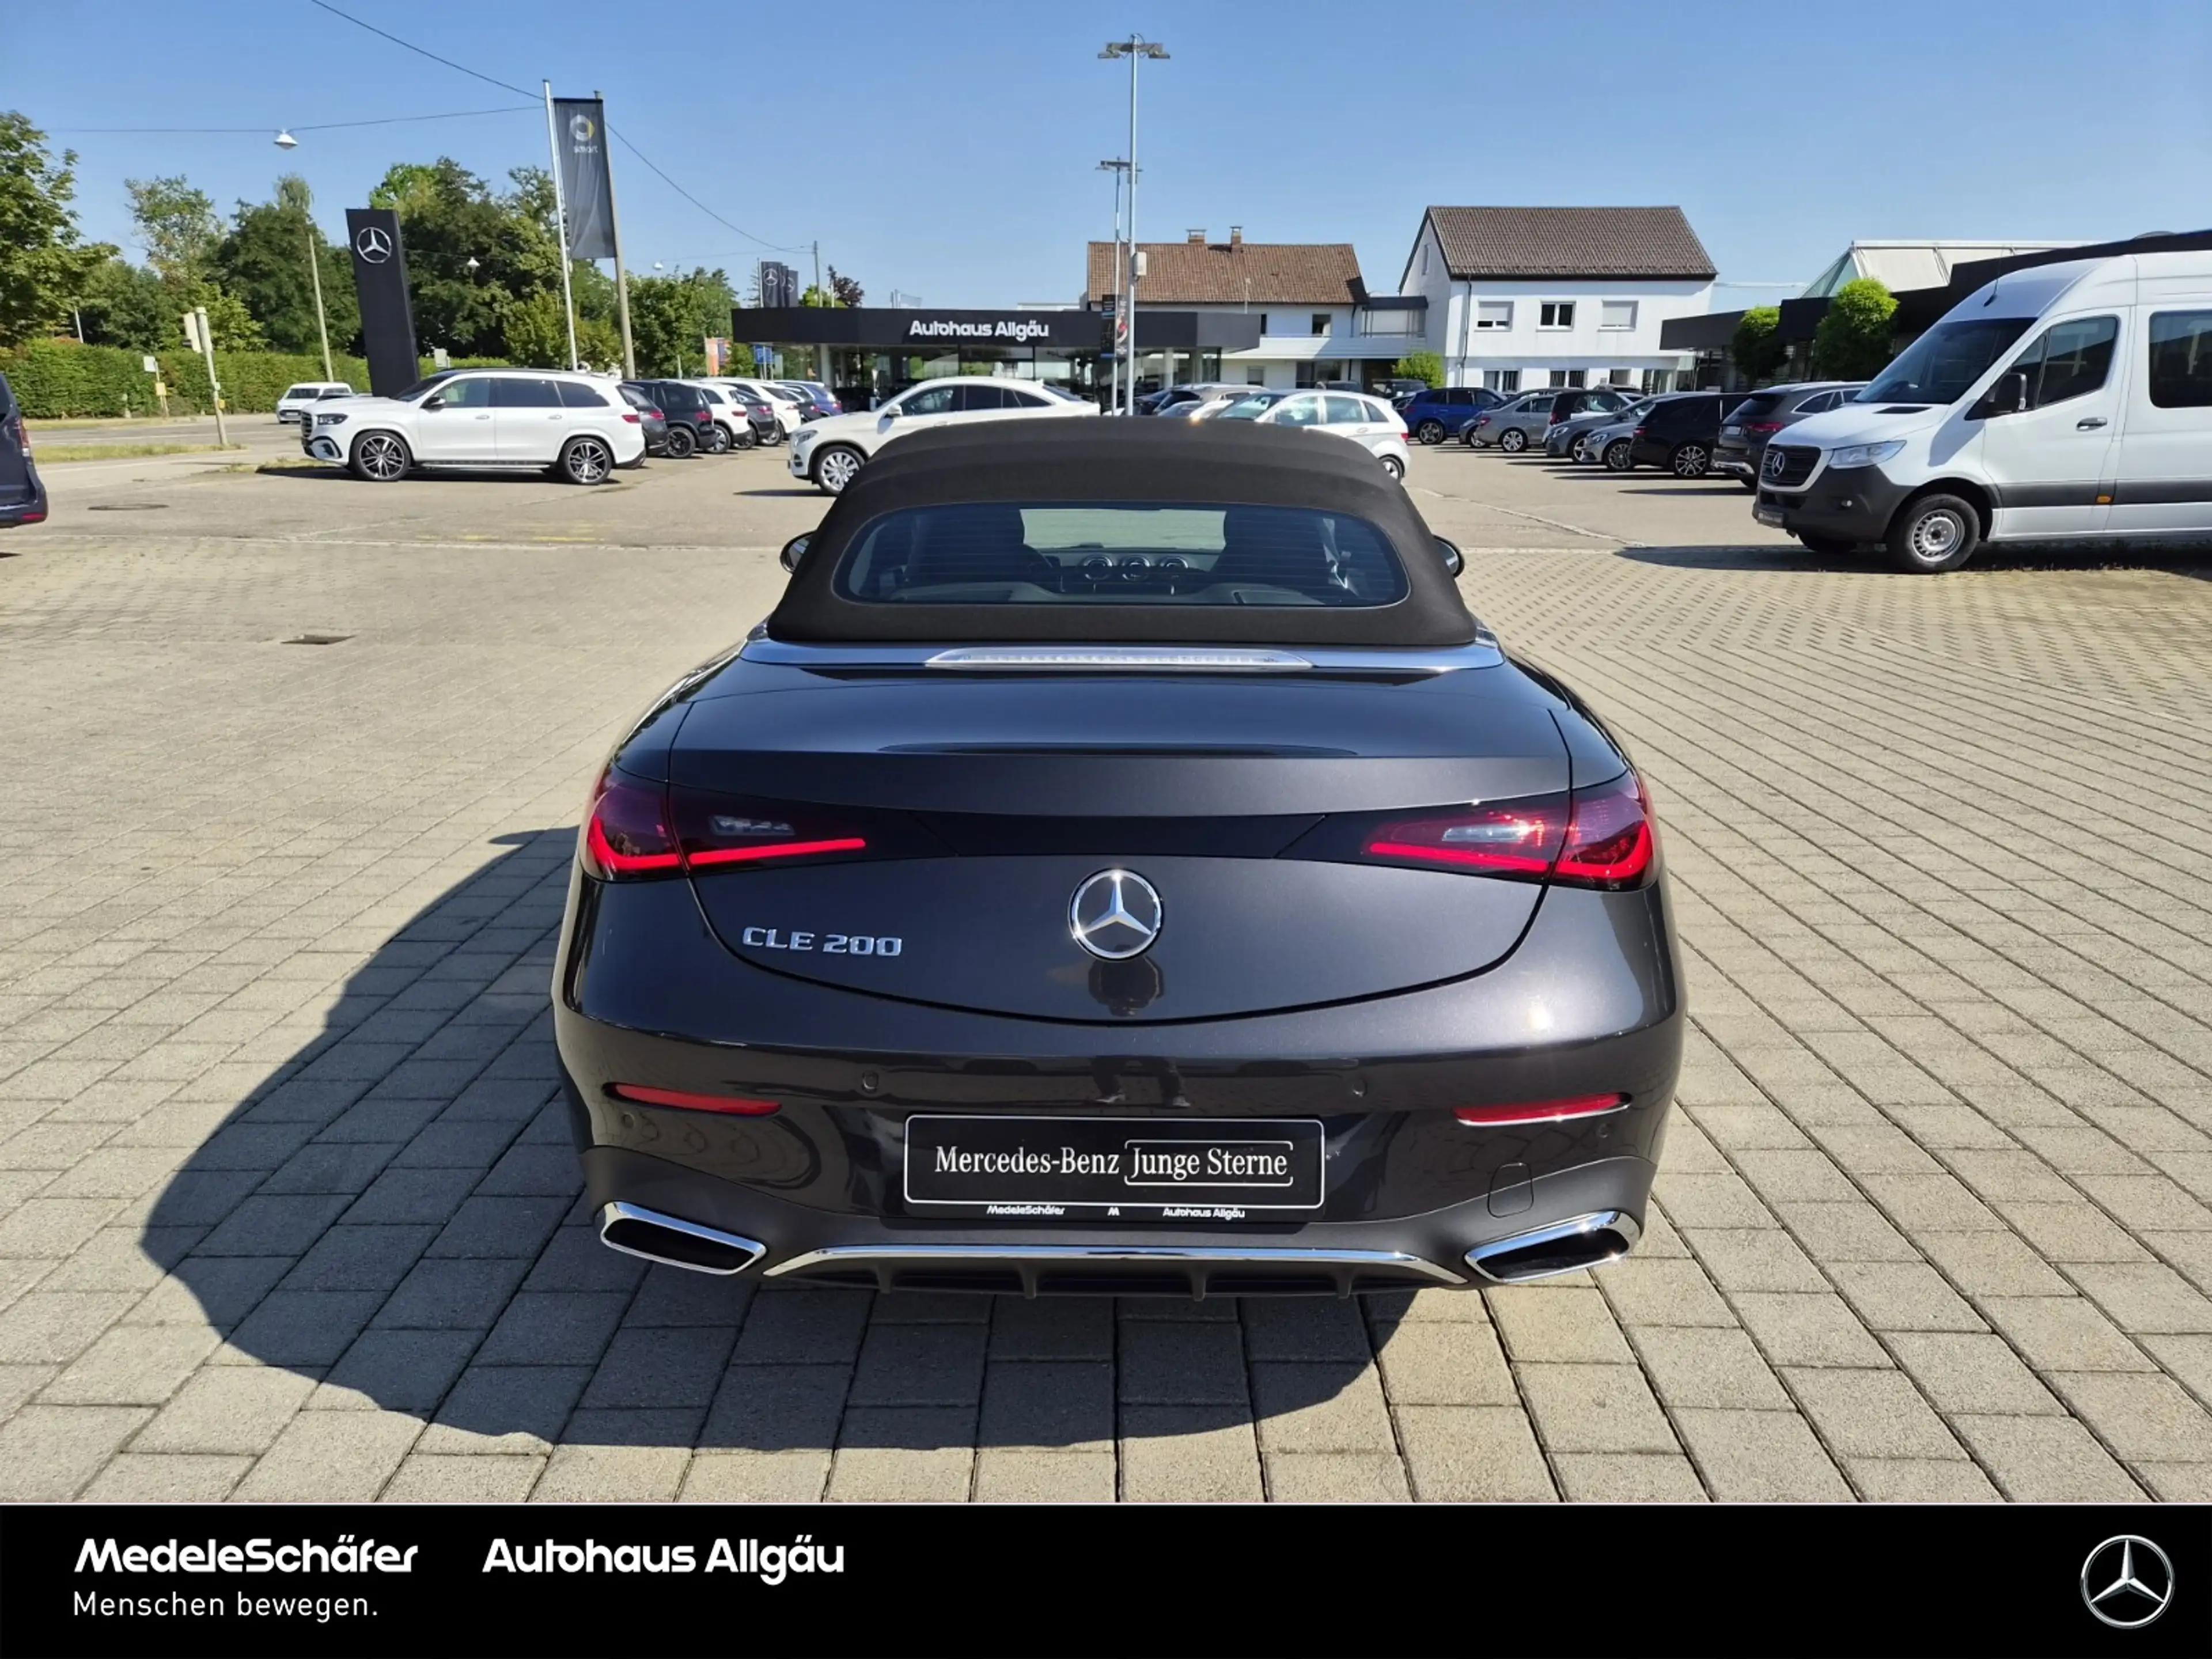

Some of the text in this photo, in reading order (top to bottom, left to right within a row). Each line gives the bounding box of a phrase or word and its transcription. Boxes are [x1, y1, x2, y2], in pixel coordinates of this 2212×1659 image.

[910, 320, 1049, 342] Autohaus Allgäu
[743, 927, 903, 956] CLE 200
[934, 1146, 1288, 1180] Mercedes-Benz Junge Sterne
[987, 1205, 1065, 1215] MedeleSchäfer
[1162, 1207, 1211, 1218] Autohaus
[1212, 1207, 1245, 1221] Allgäu
